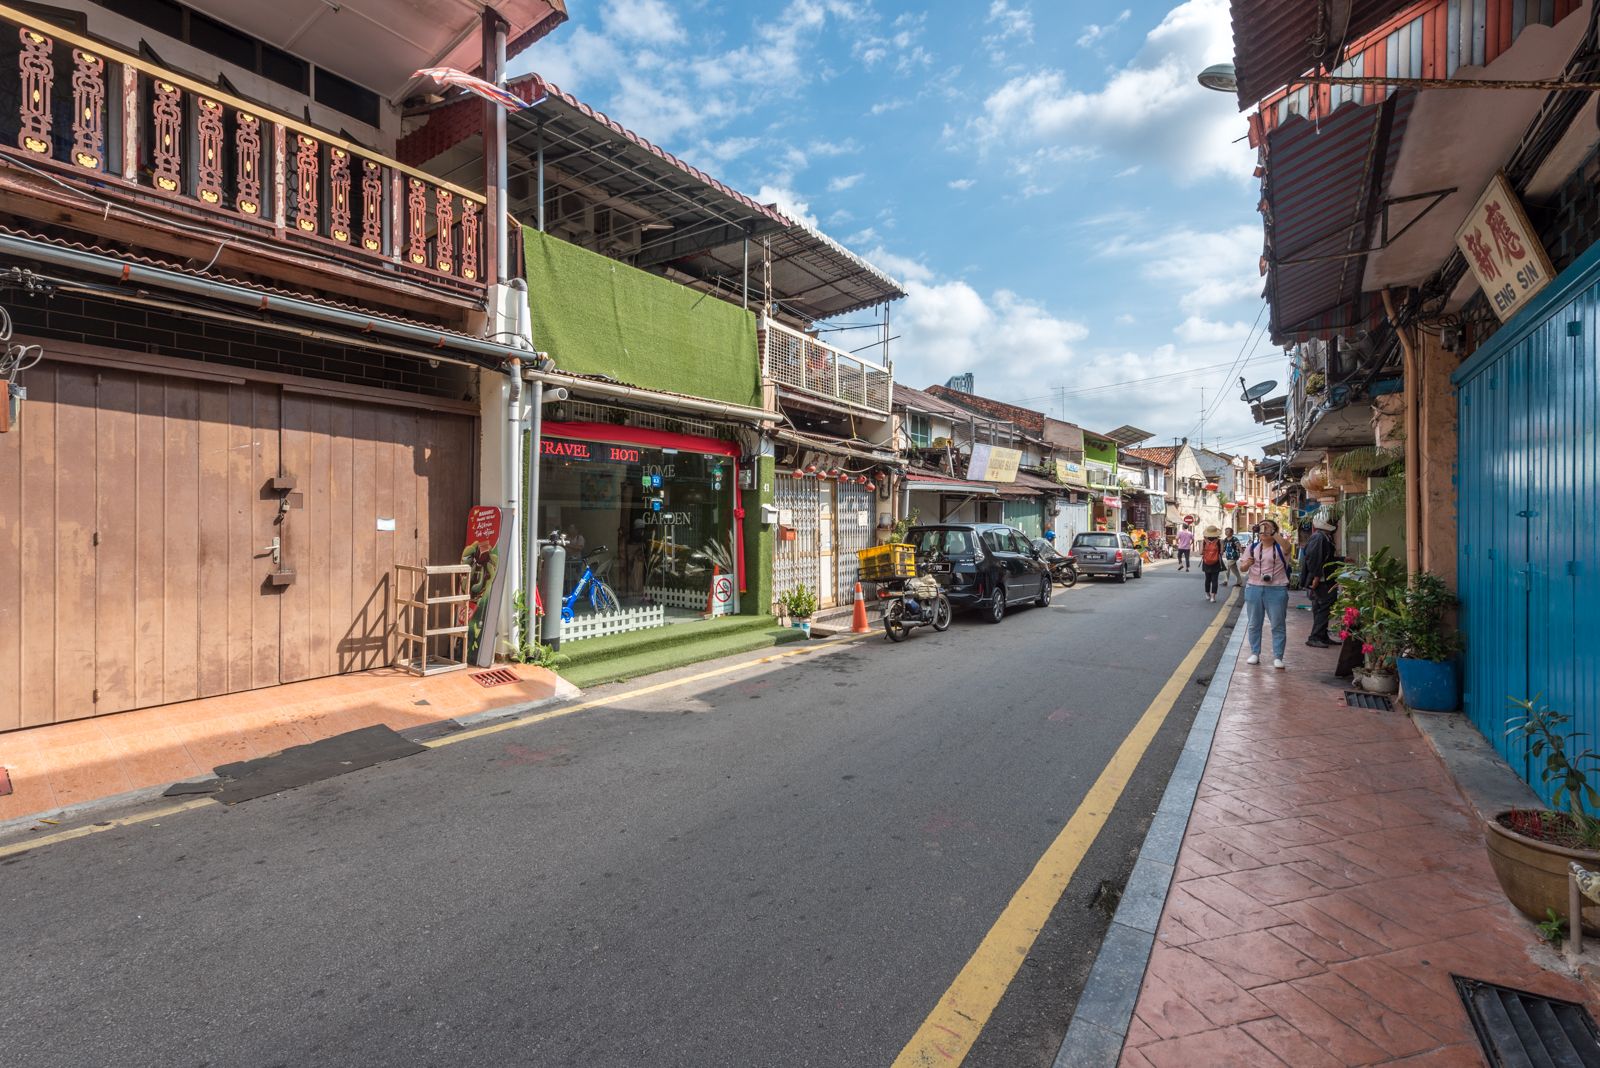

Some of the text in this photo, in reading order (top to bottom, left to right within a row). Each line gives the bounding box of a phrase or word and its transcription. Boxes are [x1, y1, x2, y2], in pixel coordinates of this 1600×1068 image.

[1494, 260, 1539, 312] ENG SIN
[540, 440, 639, 462] TRAVEL HOT
[642, 464, 676, 478] HOME
[642, 511, 691, 525] GARDEN
